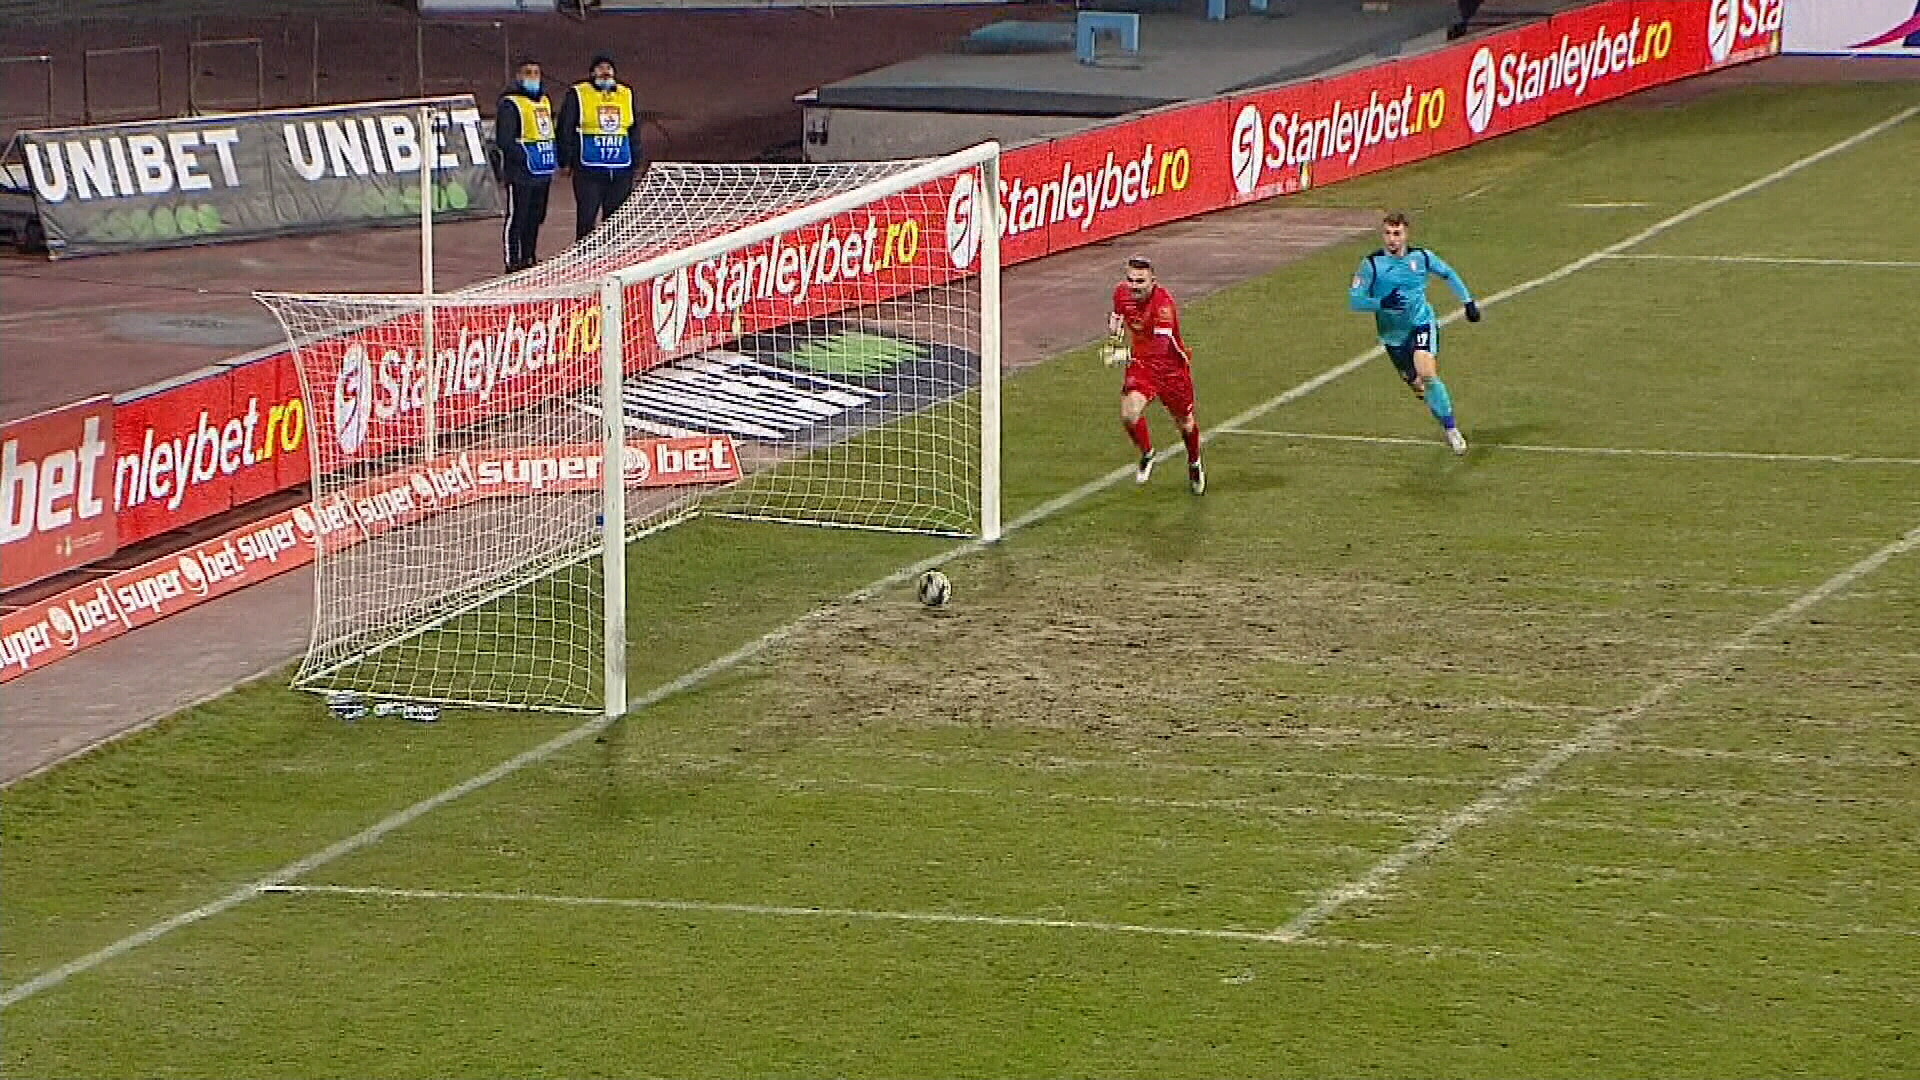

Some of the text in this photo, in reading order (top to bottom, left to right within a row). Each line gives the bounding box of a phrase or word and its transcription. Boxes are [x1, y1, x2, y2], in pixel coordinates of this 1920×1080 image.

[1497, 17, 1673, 108] Stanleybet.ro
[25, 129, 240, 203] UNIBET
[283, 107, 487, 181] UNIBET
[1265, 85, 1446, 169] Stanleybet.ro
[691, 215, 919, 319] Stanleybet.ro
[375, 303, 601, 420] Stanleybet.ro
[0, 416, 106, 545] bet
[113, 397, 304, 513] nleybet.ro
[477, 434, 732, 489] super bet
[70, 591, 118, 634] bet
[118, 571, 184, 613] super
[200, 544, 244, 583] bet
[239, 520, 297, 563] super
[356, 483, 414, 526] super
